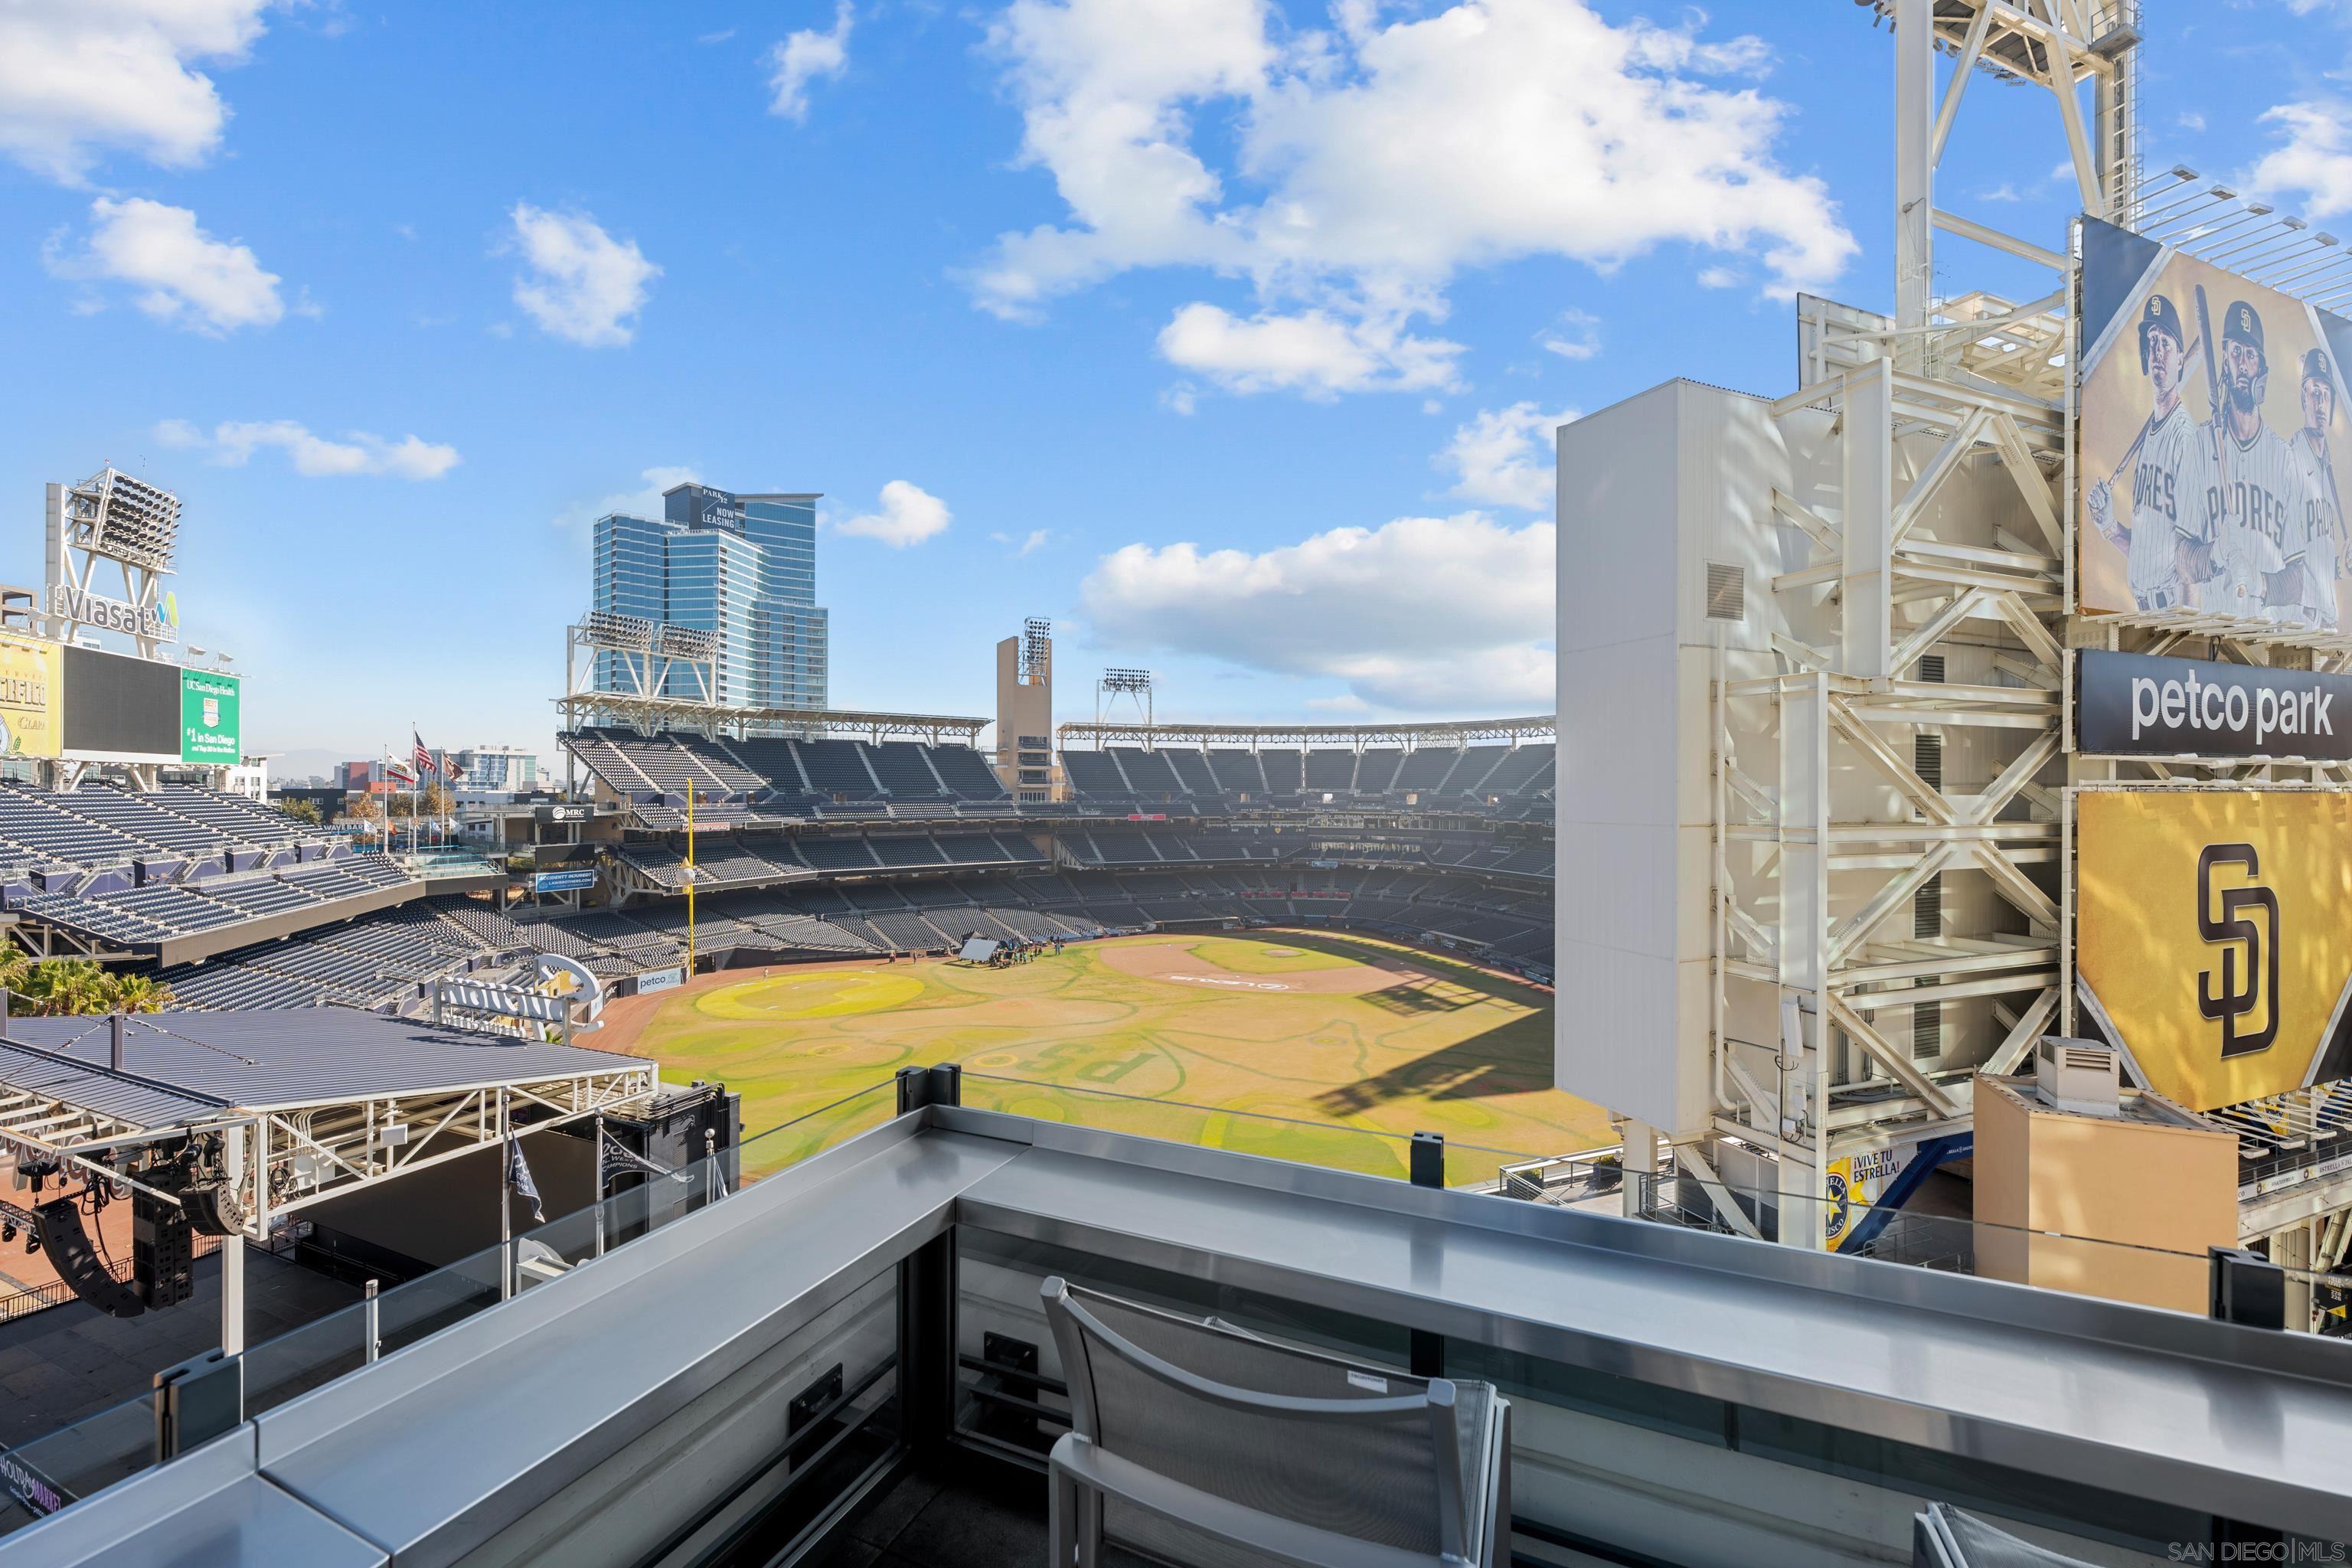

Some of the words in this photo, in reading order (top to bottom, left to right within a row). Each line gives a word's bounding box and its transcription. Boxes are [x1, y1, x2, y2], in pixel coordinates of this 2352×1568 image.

[703, 488, 723, 498] PARK
[702, 513, 735, 528] LEASING
[717, 507, 734, 519] NOW
[64, 584, 150, 636] Viasat
[187, 680, 196, 690] UC
[195, 681, 206, 692] San
[205, 684, 220, 695] Diego
[220, 686, 235, 697] Health
[2132, 668, 2249, 740] petco
[2256, 686, 2334, 745] park
[198, 733, 204, 743] in
[204, 733, 217, 743] San
[217, 735, 236, 746] Diego
[2197, 842, 2280, 1059] SD
[640, 975, 666, 989] petco
[1854, 1153, 1880, 1170] ¡VIVE
[1880, 1150, 1893, 1162] TU
[1854, 1163, 1900, 1183] ESTRELLA!
[0, 1455, 34, 1499] HOLIDAY
